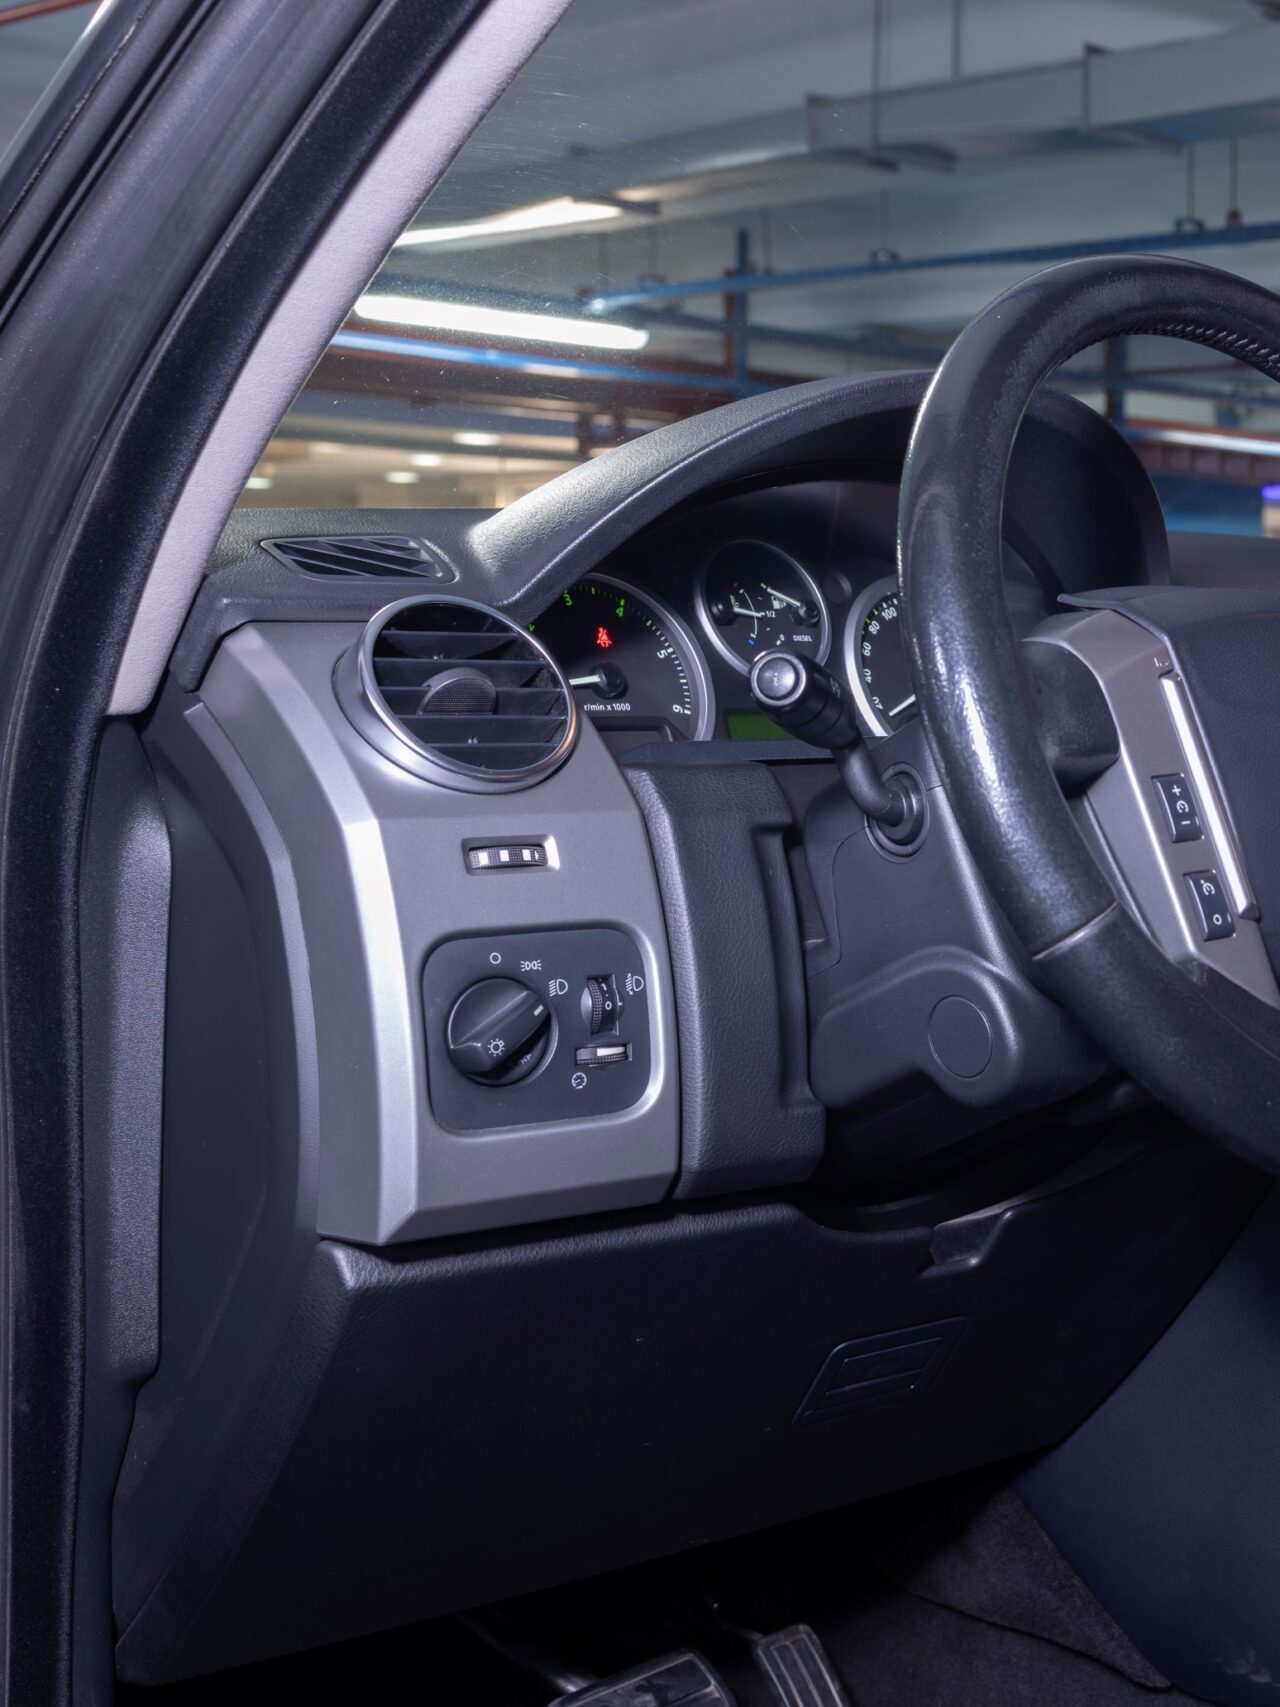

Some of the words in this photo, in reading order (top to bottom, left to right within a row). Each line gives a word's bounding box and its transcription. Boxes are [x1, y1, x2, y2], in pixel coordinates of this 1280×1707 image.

[563, 591, 573, 606] 3
[616, 606, 624, 617] 4
[882, 607, 897, 620] 100
[869, 621, 880, 634] 80
[657, 650, 668, 659] 5
[862, 642, 872, 656] 60
[864, 669, 873, 683] 40
[584, 703, 605, 711] r/min
[613, 703, 630, 711] 1000
